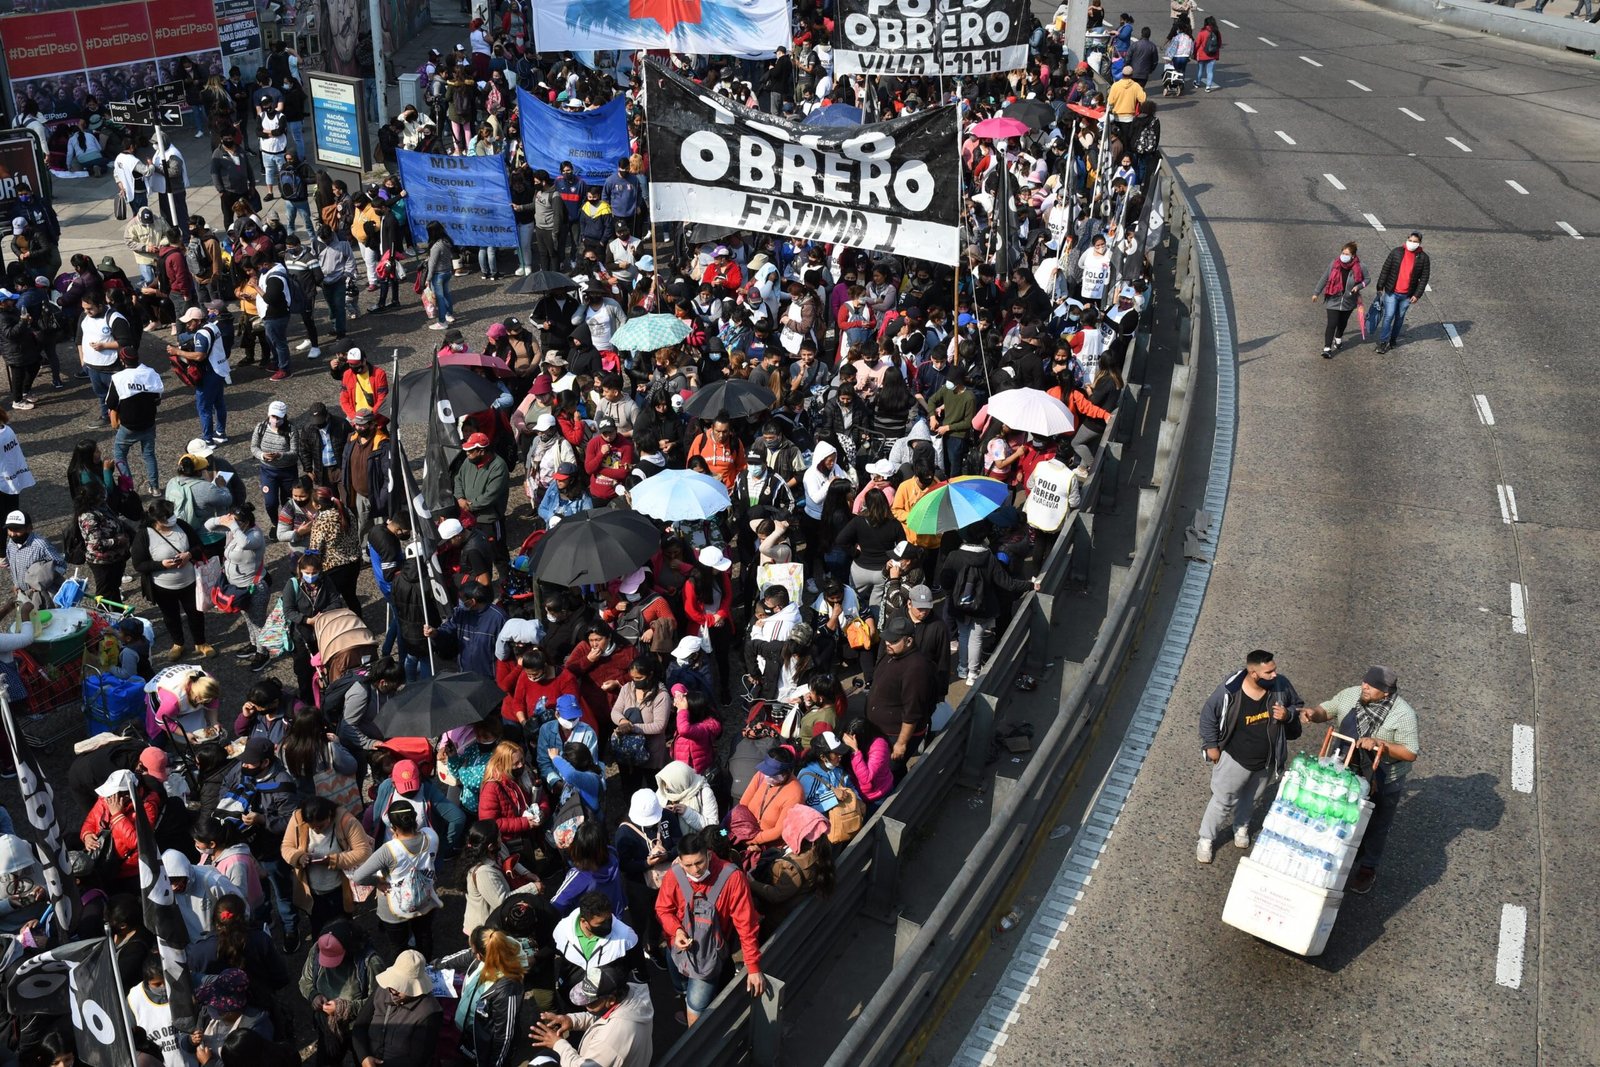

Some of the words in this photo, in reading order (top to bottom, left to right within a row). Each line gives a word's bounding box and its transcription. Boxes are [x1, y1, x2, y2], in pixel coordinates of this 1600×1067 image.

[156, 23, 214, 40] #DarElPaso
[845, 11, 1011, 50] OBRERO
[85, 33, 149, 50] #DarElPaso
[9, 43, 78, 60] #DarElPaso
[858, 53, 926, 75] VILLA
[324, 119, 349, 128] PROVINCIA
[327, 125, 351, 135] MUNICIPIO
[329, 131, 347, 139] JUEGAN
[568, 149, 604, 159] REGIONAL
[430, 156, 470, 170] MDL
[681, 130, 935, 212] OBRERO
[427, 175, 476, 187] REGIONAL
[436, 204, 448, 213] DE
[472, 224, 513, 233] ZAMORA
[738, 194, 868, 248] FATIMA
[874, 215, 902, 253] I
[127, 383, 149, 392] MDL
[4, 440, 18, 453] MDL
[1037, 478, 1058, 492] POLO
